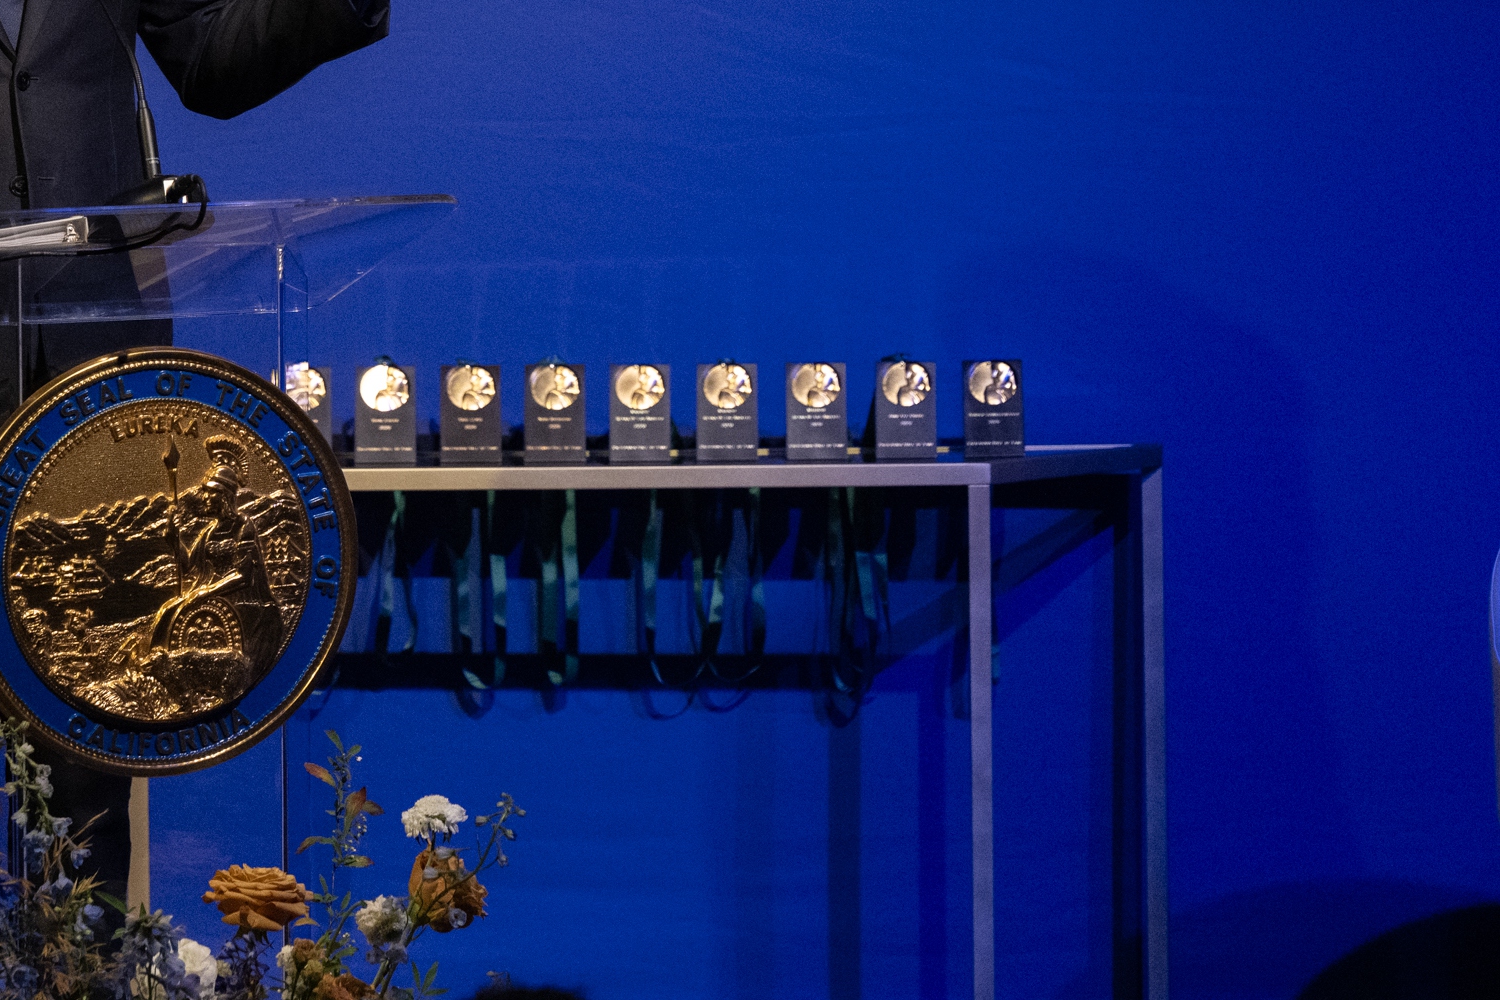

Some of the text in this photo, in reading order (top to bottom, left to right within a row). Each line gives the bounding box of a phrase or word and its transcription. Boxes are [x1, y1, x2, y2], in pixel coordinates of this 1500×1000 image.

[110, 415, 199, 442] EUREKA
[60, 376, 133, 425] SEAL
[156, 370, 192, 396] OF
[216, 380, 268, 428] THE
[278, 431, 336, 532] STATE
[314, 554, 338, 598] OF
[68, 709, 250, 755] CALIFORNIA
